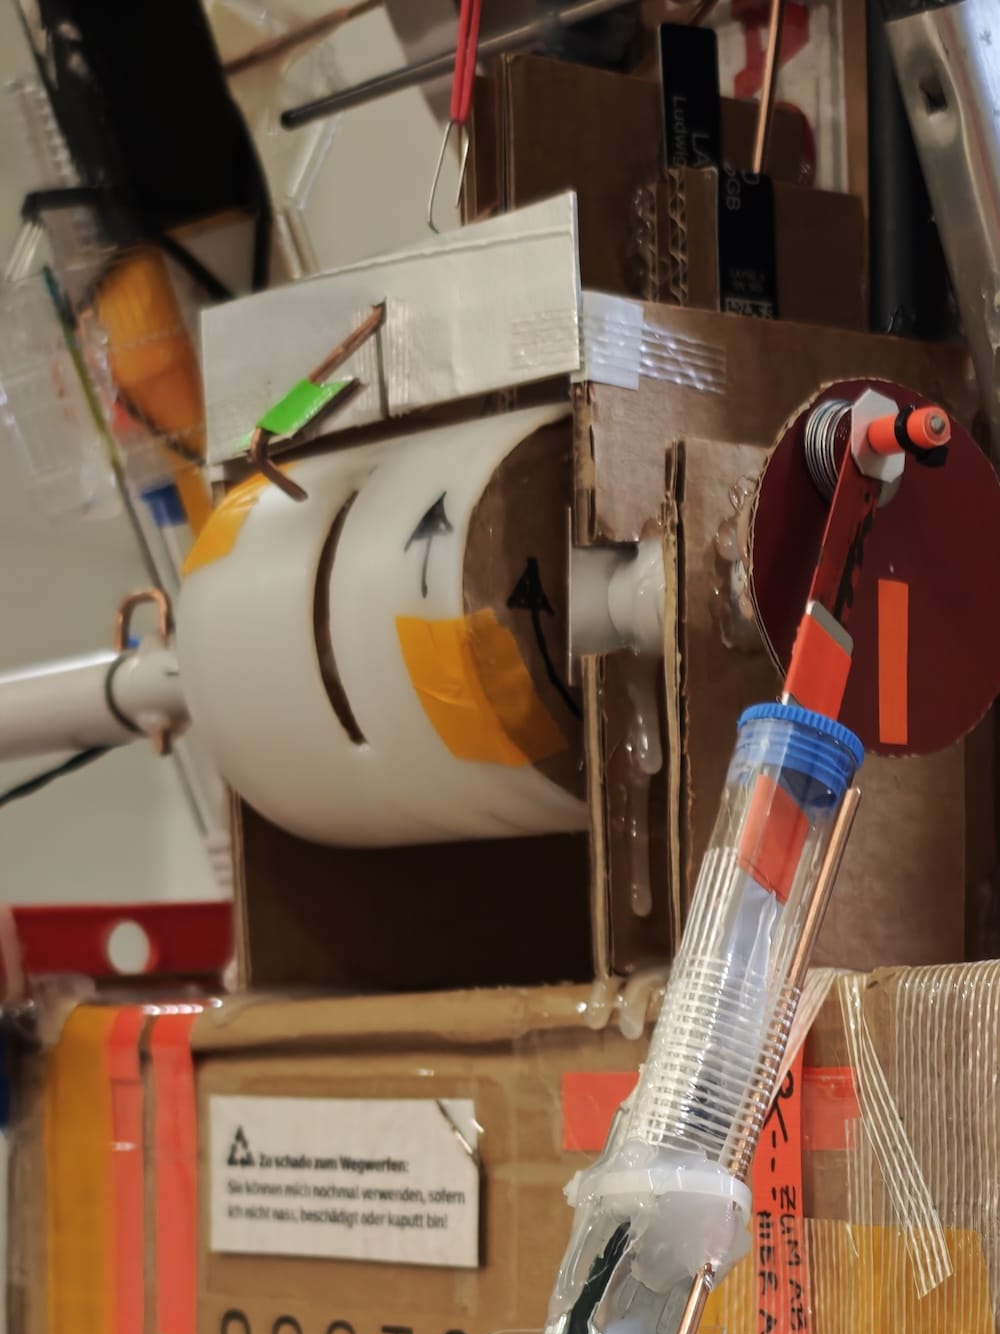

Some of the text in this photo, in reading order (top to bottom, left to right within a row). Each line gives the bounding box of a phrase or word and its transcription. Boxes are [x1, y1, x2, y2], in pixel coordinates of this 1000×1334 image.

[429, 1187, 465, 1204] sofern
[387, 1212, 424, 1230] kaputt
[426, 1213, 448, 1229] bin!
[779, 1185, 801, 1266] ZUM
[756, 1210, 777, 1297] HIER
